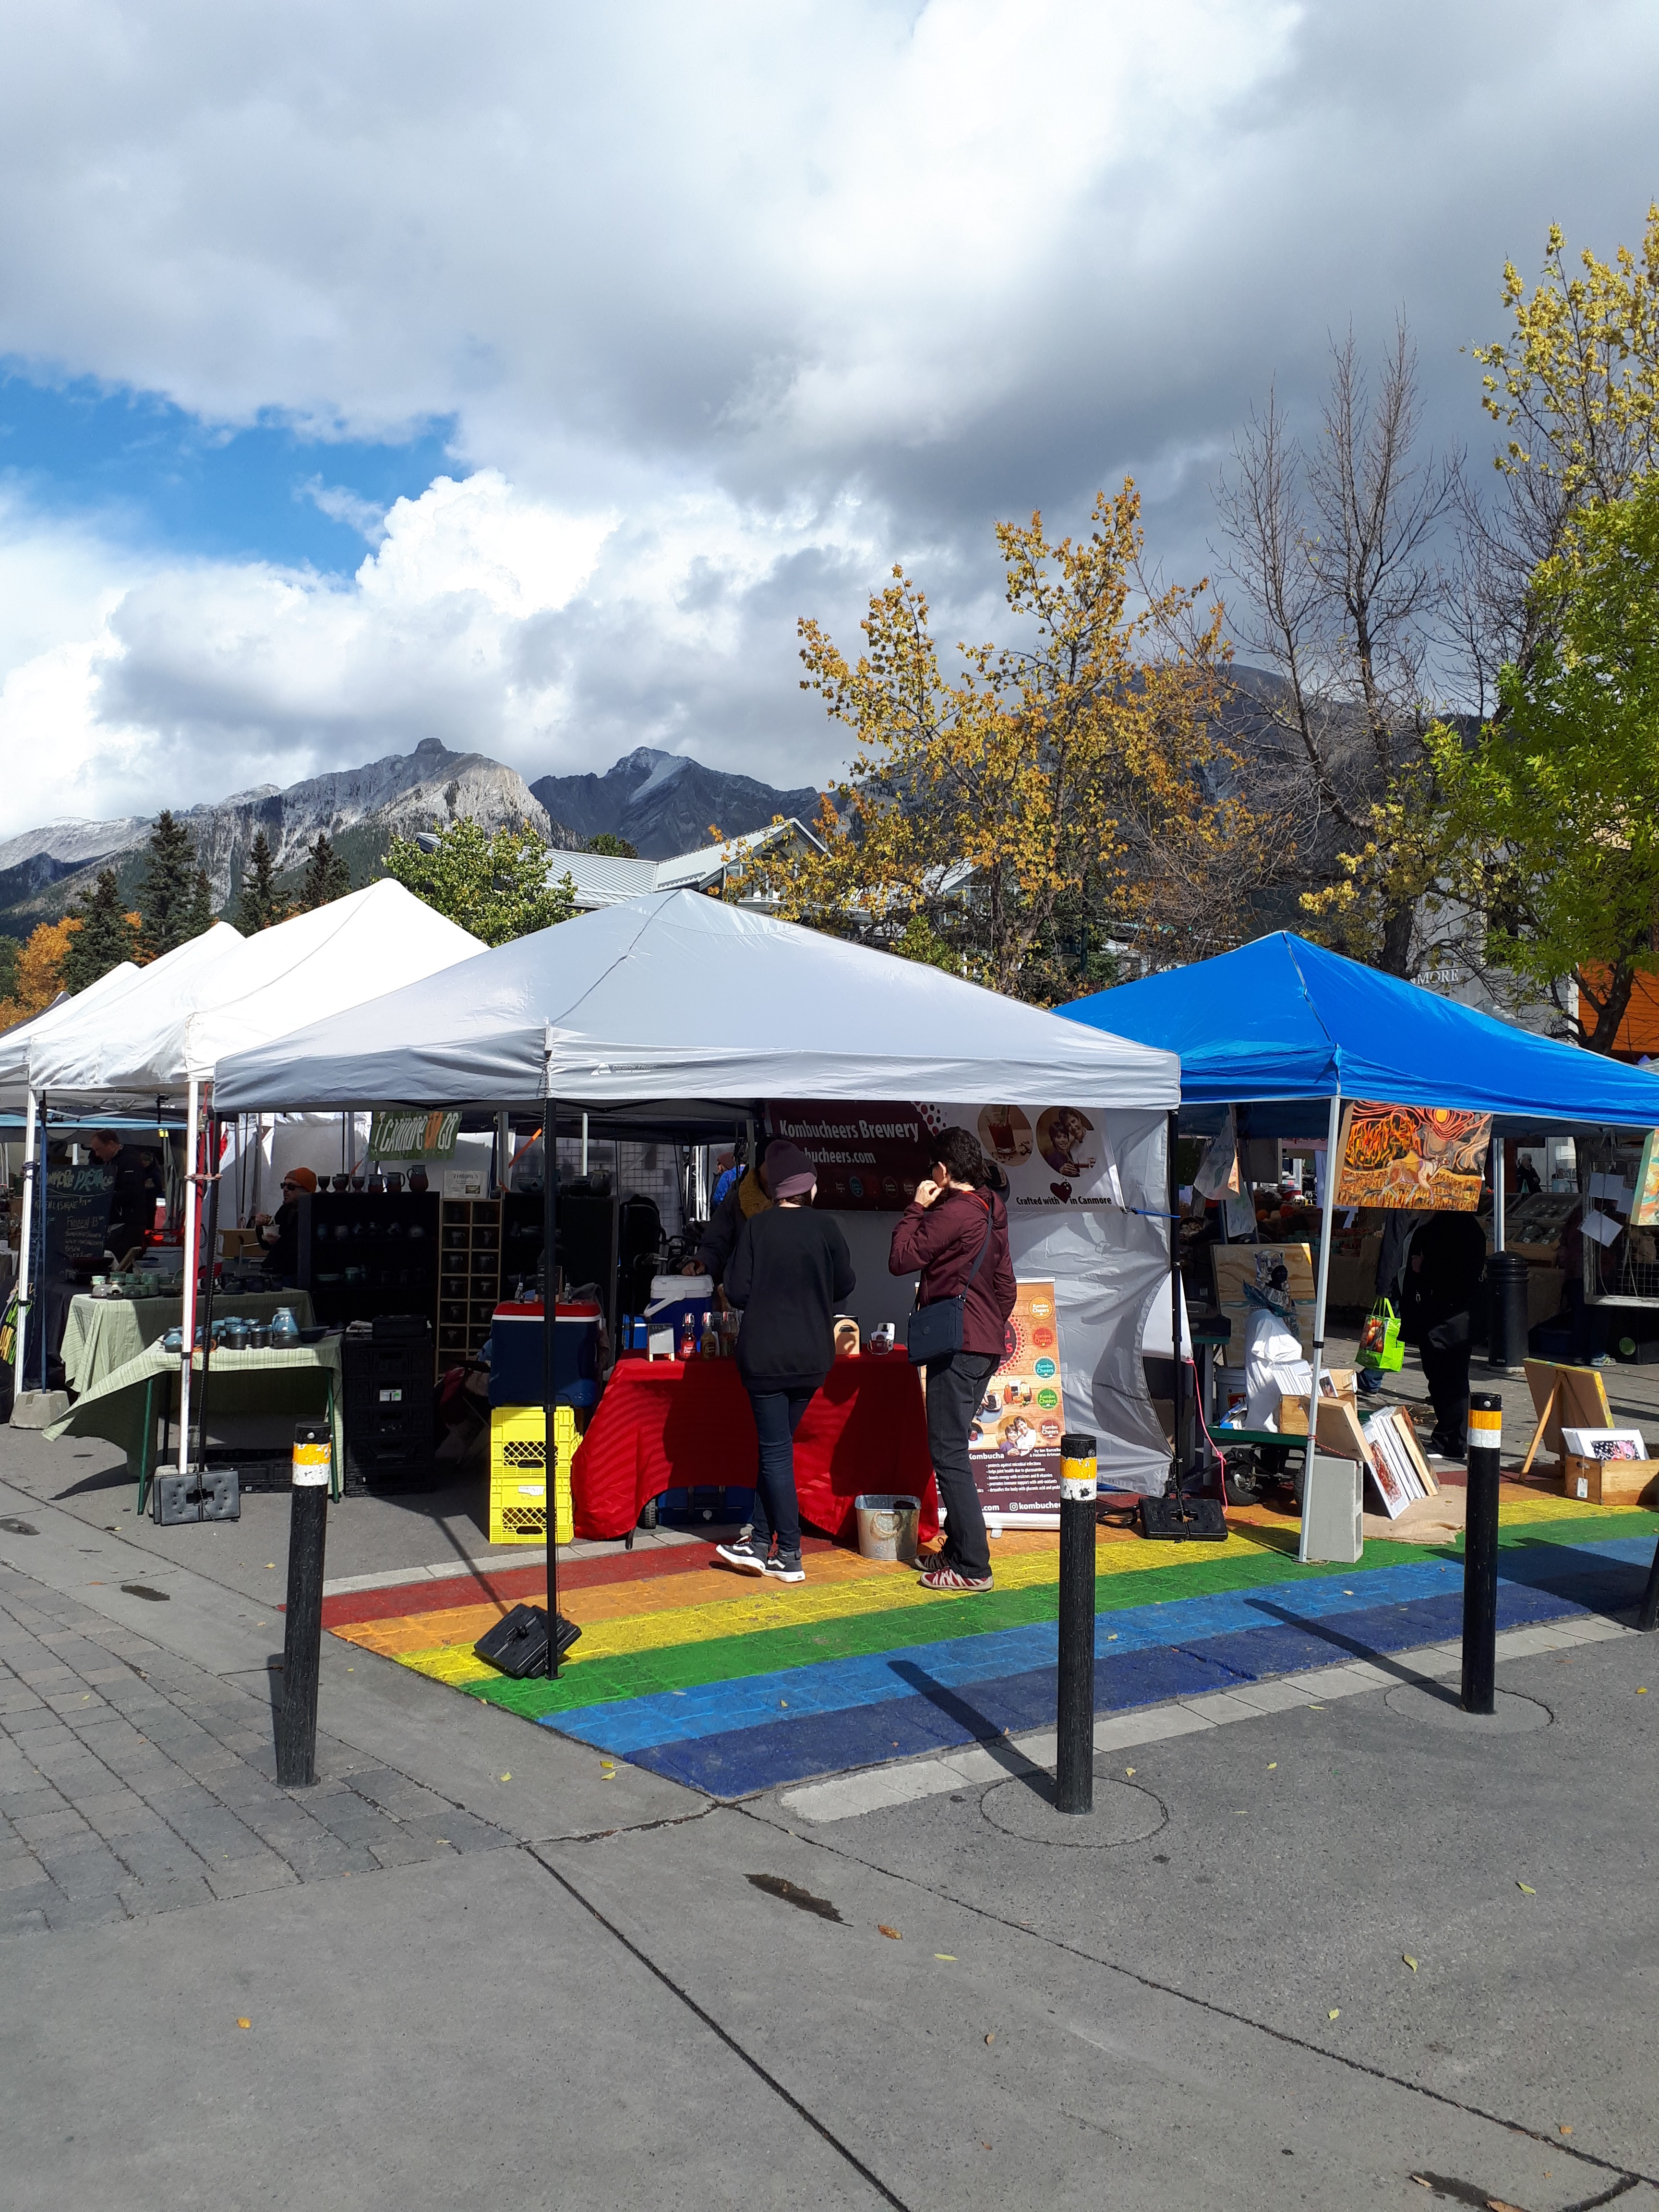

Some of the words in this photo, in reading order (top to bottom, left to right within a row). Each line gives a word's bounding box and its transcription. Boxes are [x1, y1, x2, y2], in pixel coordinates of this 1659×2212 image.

[779, 1119, 858, 1139] Kombucheers
[859, 1119, 918, 1143] Brewery
[802, 1147, 877, 1164] bucheers.com
[1016, 1197, 1042, 1205] Crafted
[1043, 1197, 1060, 1205] with
[1070, 1196, 1078, 1204] in
[1078, 1196, 1112, 1204] Canmore
